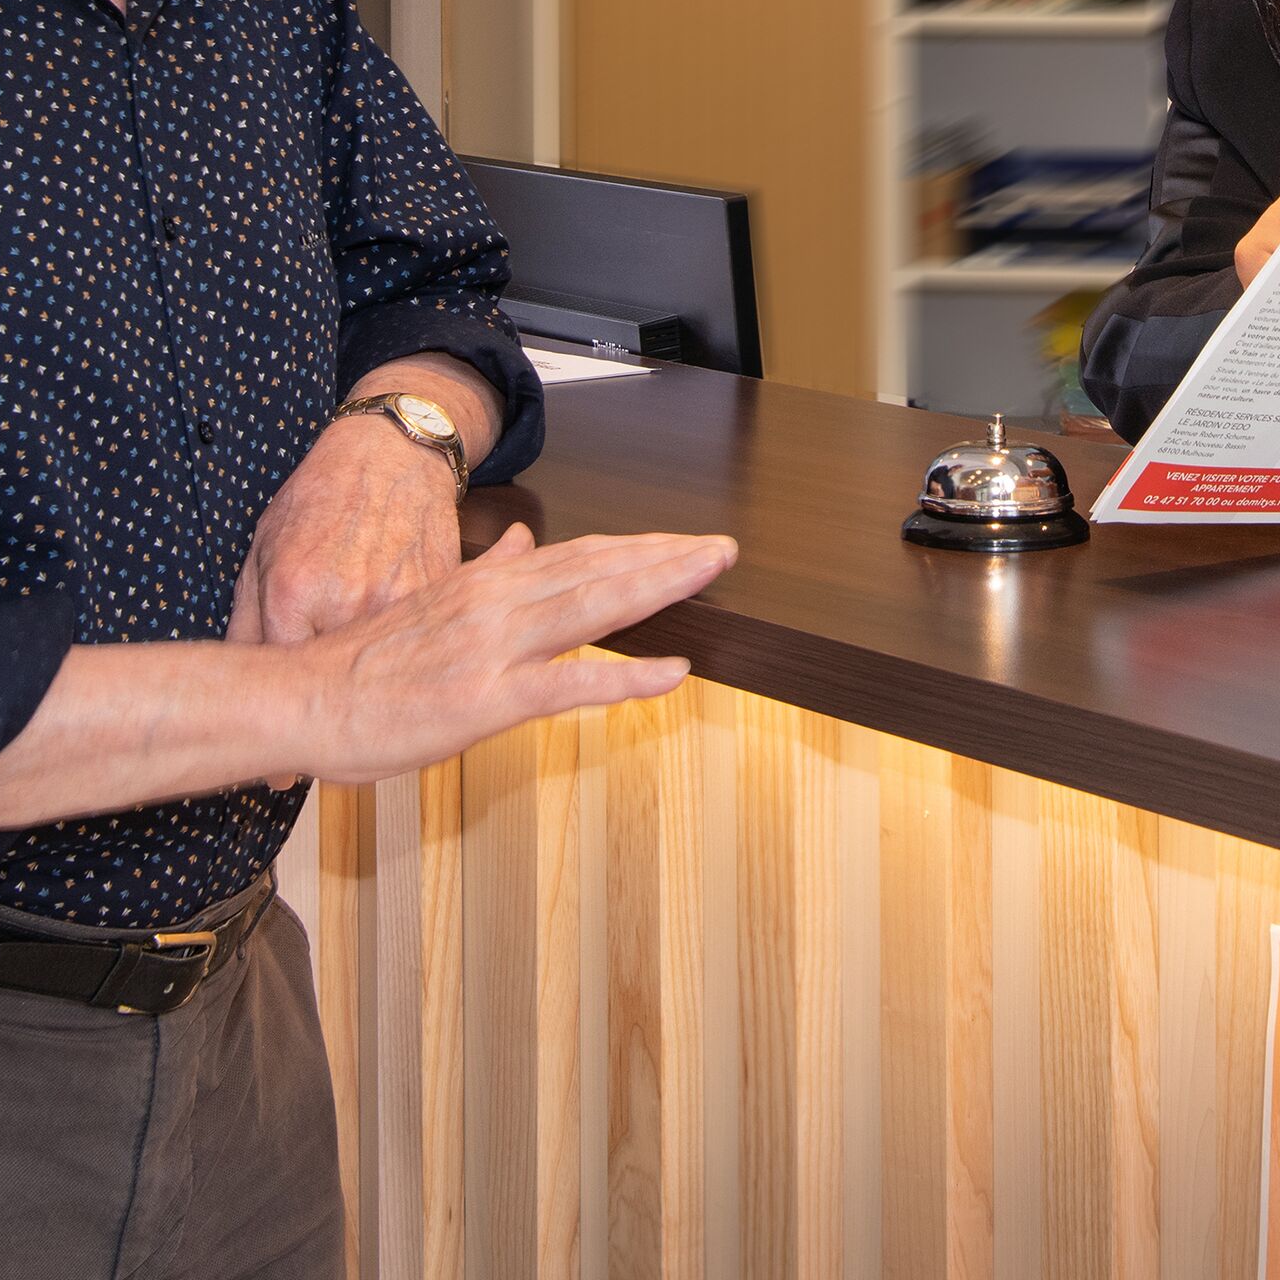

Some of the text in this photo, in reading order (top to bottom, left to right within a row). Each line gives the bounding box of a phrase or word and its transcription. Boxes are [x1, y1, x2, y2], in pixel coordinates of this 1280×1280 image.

[1185, 407, 1235, 419] RÉSIDENCE
[1234, 412, 1274, 422] SERVICES
[1178, 418, 1191, 426] LE
[1190, 419, 1223, 429] JARDIN
[1171, 428, 1198, 437] Avenue
[1199, 431, 1224, 439] Robert
[1166, 471, 1201, 482] VENEZ
[1201, 474, 1238, 482] VISITER
[1238, 475, 1271, 483] VOTRE
[1190, 484, 1263, 493] APPARTEMENT
[1143, 494, 1160, 505] 02
[1160, 496, 1176, 505] 47
[1174, 496, 1189, 506] 51
[1190, 497, 1205, 506] 70
[1205, 497, 1220, 506] 00
